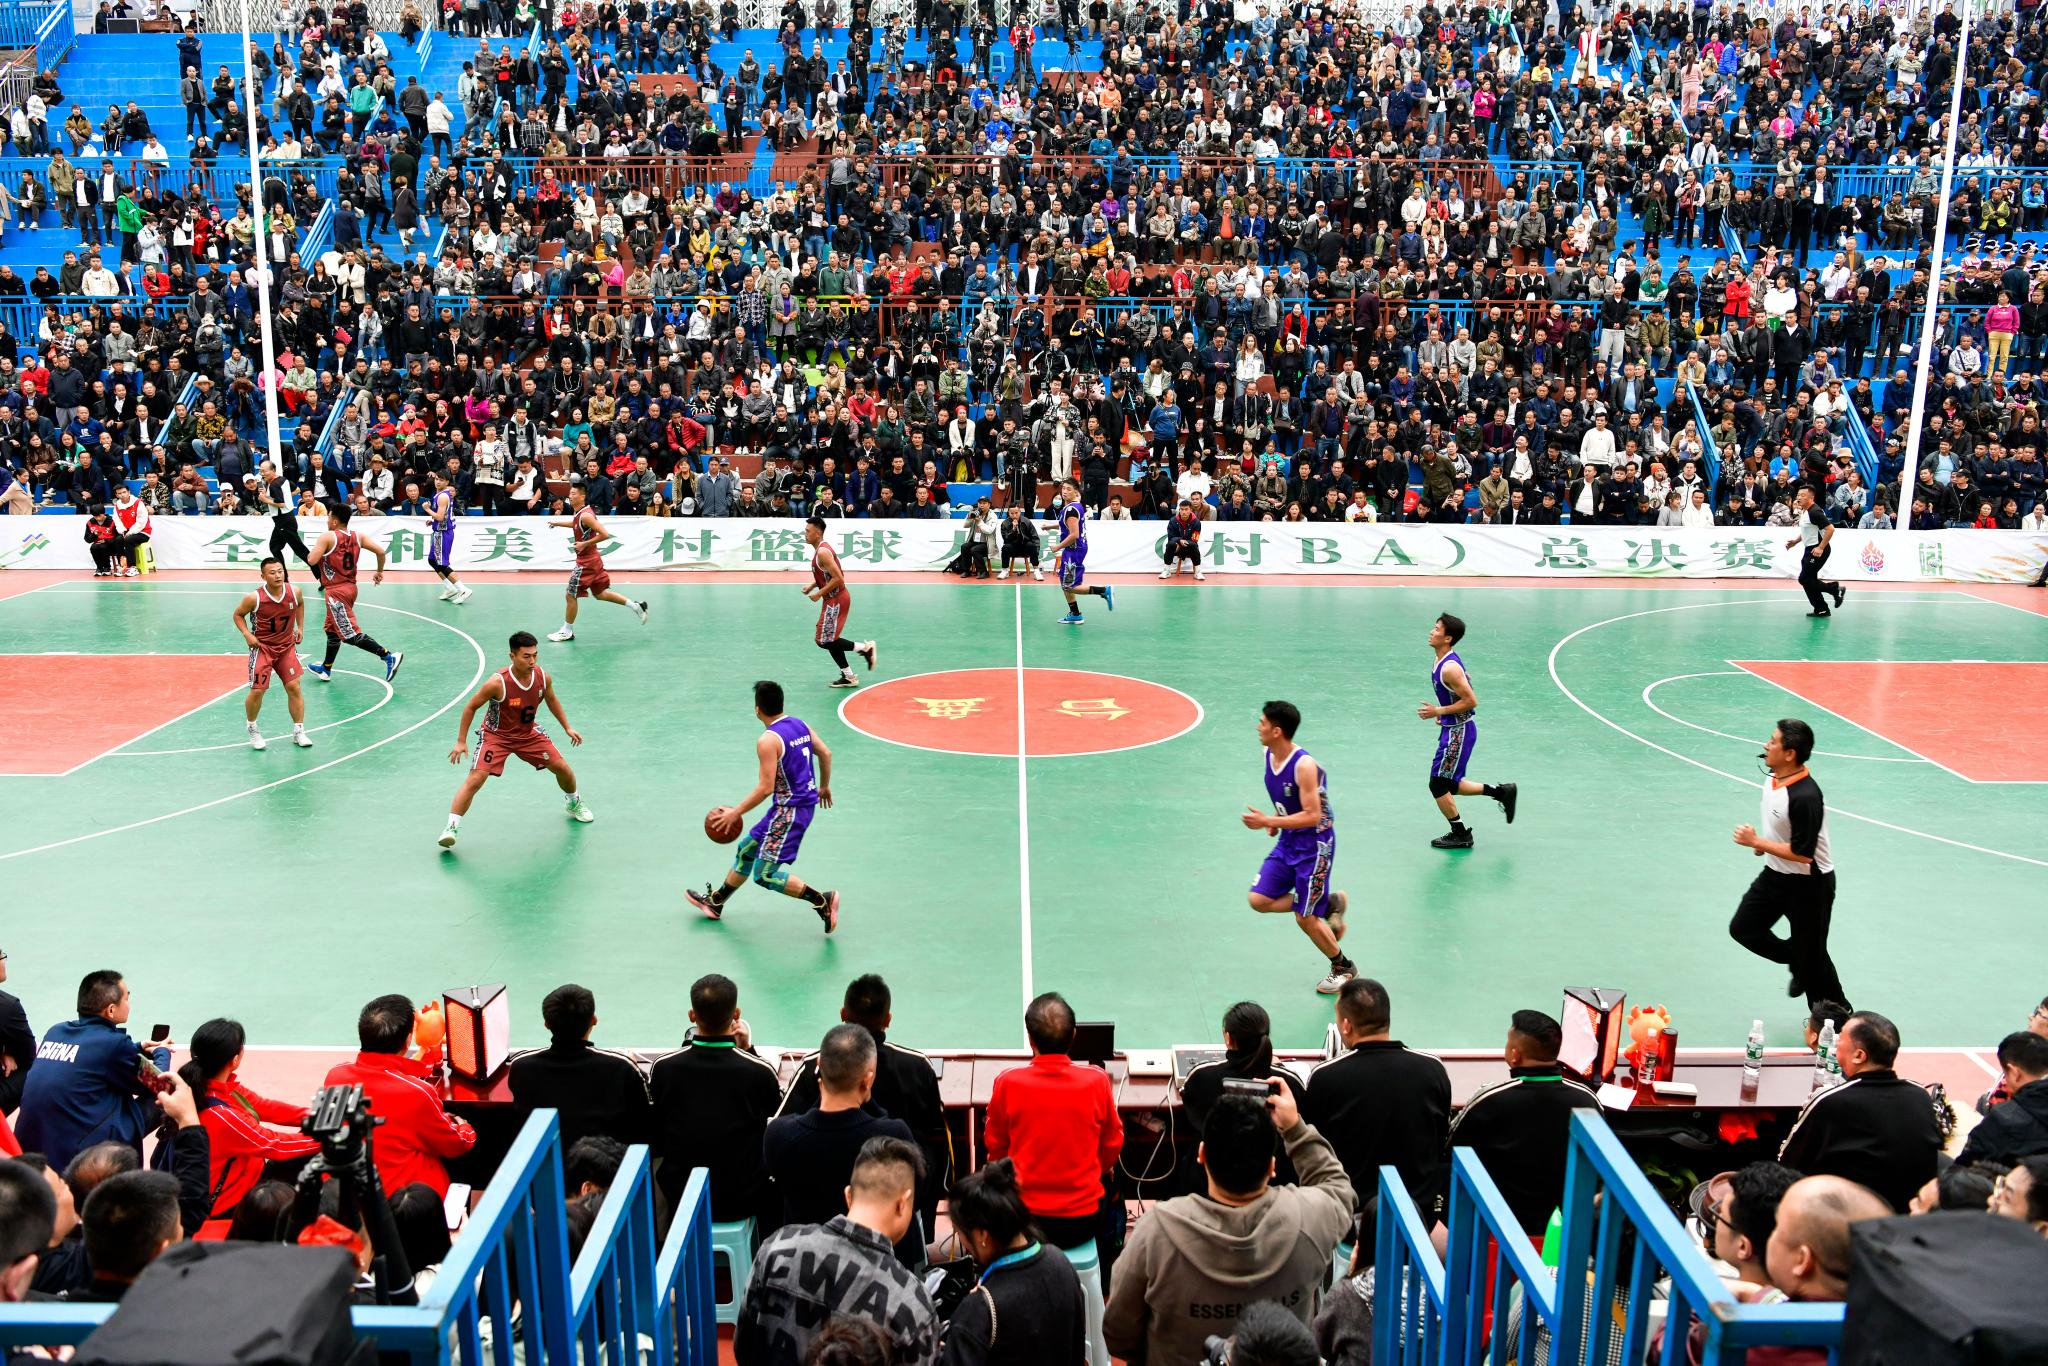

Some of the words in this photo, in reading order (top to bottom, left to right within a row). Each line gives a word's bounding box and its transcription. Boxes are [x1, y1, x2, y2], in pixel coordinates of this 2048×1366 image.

[268, 615, 290, 633] 17
[254, 673, 268, 685] 17
[521, 706, 536, 724] 6
[483, 750, 494, 763] 6
[36, 1041, 80, 1063] CHINA
[1189, 1289, 1300, 1320] ESSELS
